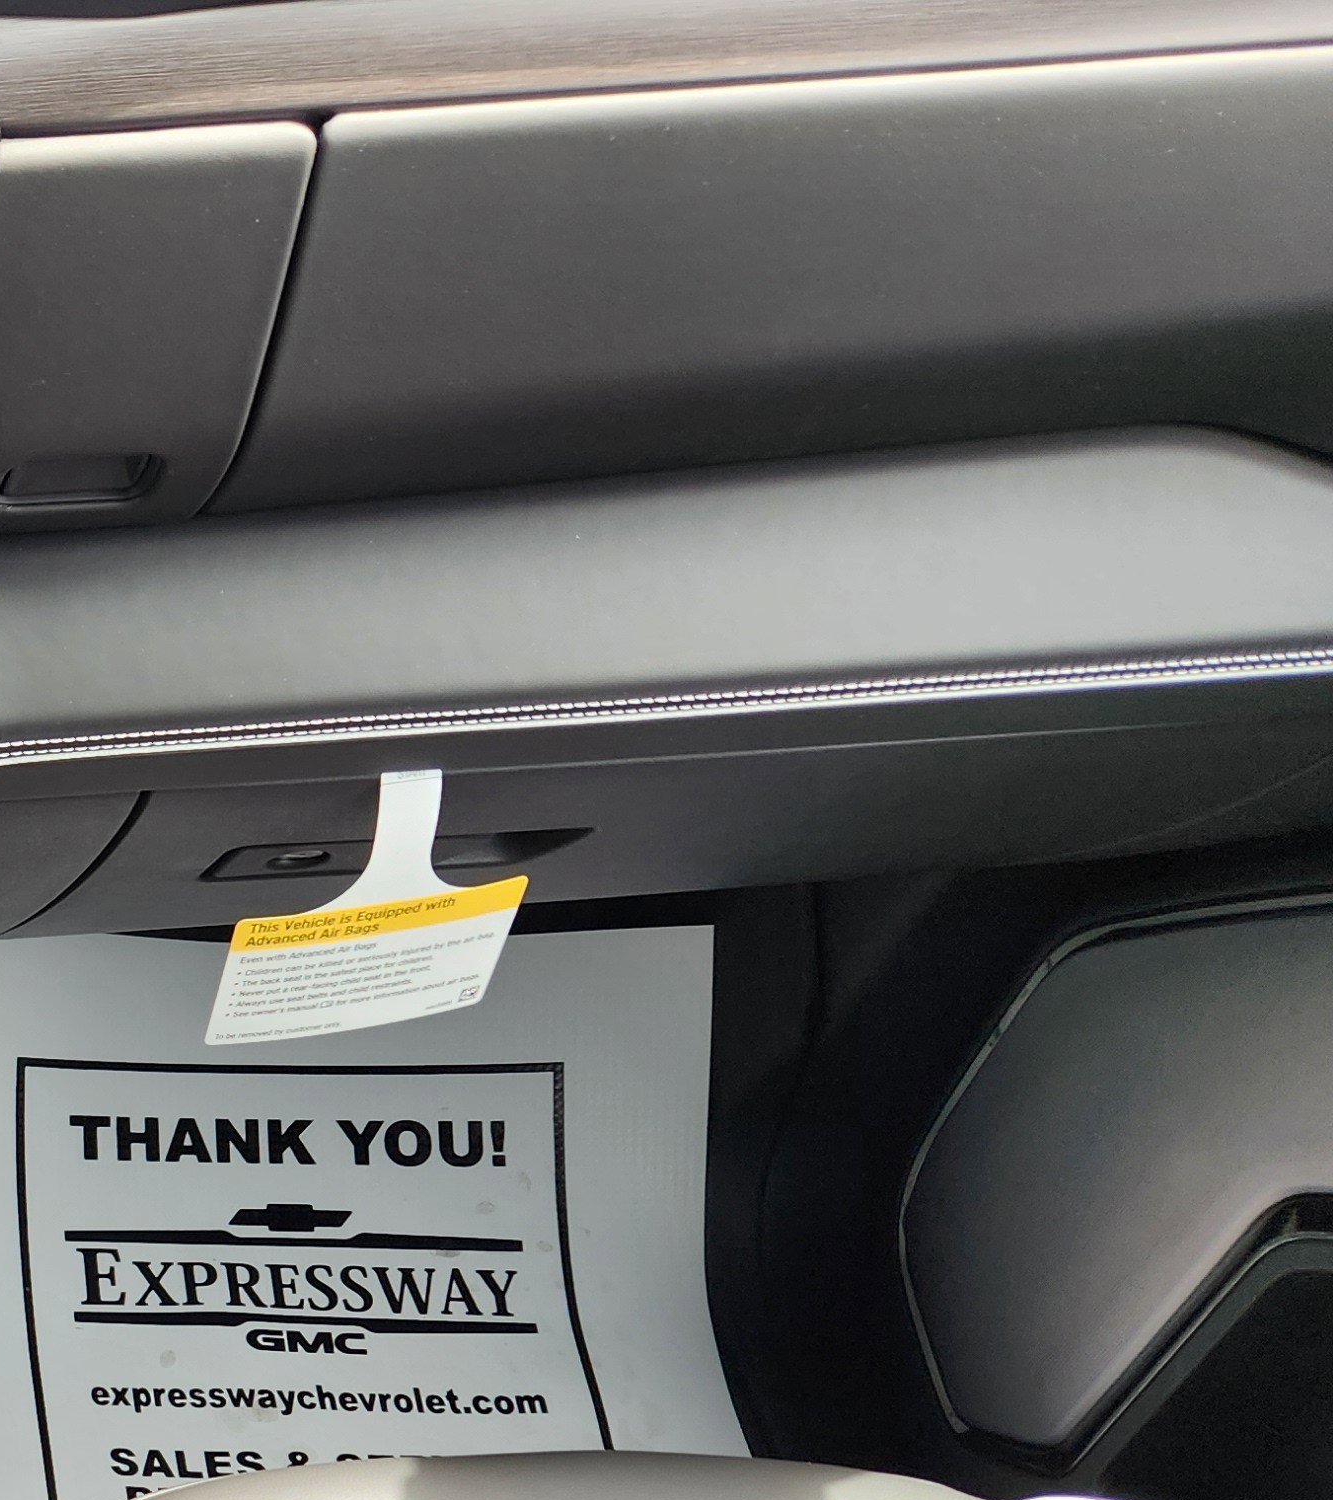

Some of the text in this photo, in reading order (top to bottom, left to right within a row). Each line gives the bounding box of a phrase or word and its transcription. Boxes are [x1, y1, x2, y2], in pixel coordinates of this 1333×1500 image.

[250, 896, 457, 935] This Vehicle is Equipped with
[245, 923, 380, 947] Advanced Air Bags
[69, 1114, 507, 1167] THANK YOU!
[75, 1247, 518, 1318] EXPRESSWAY
[245, 1328, 369, 1356] GMC
[90, 1383, 550, 1416] expresswaychevrolet.com
[110, 1447, 265, 1479] SALES
